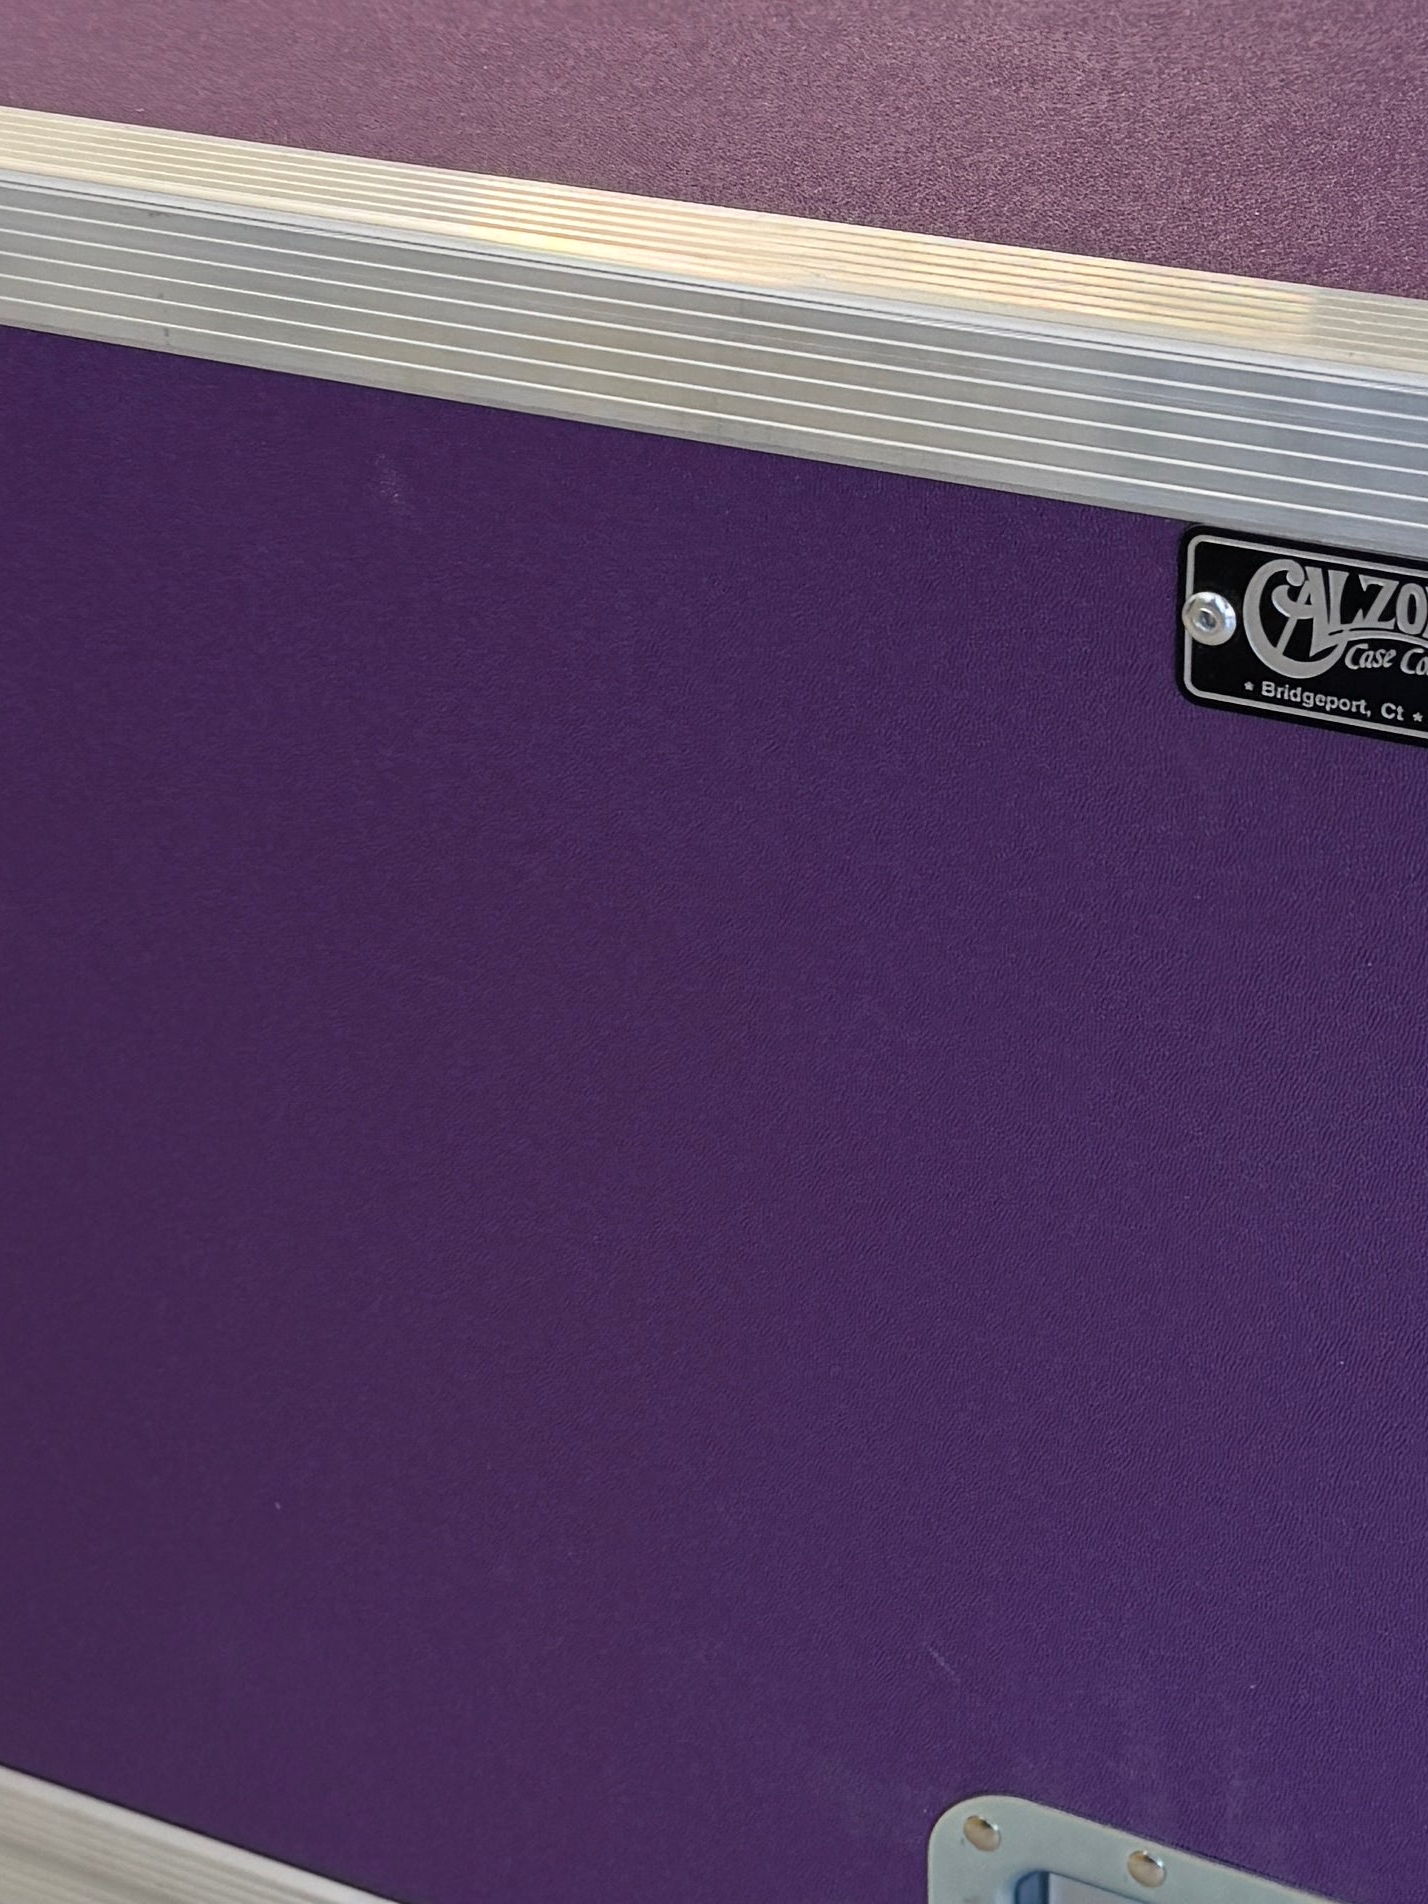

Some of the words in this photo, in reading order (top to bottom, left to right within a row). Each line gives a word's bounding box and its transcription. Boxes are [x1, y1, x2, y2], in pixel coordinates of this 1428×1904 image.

[1345, 643, 1396, 670] Case
[1260, 681, 1372, 718] Bridgeport,
[1380, 702, 1404, 721] Ct
